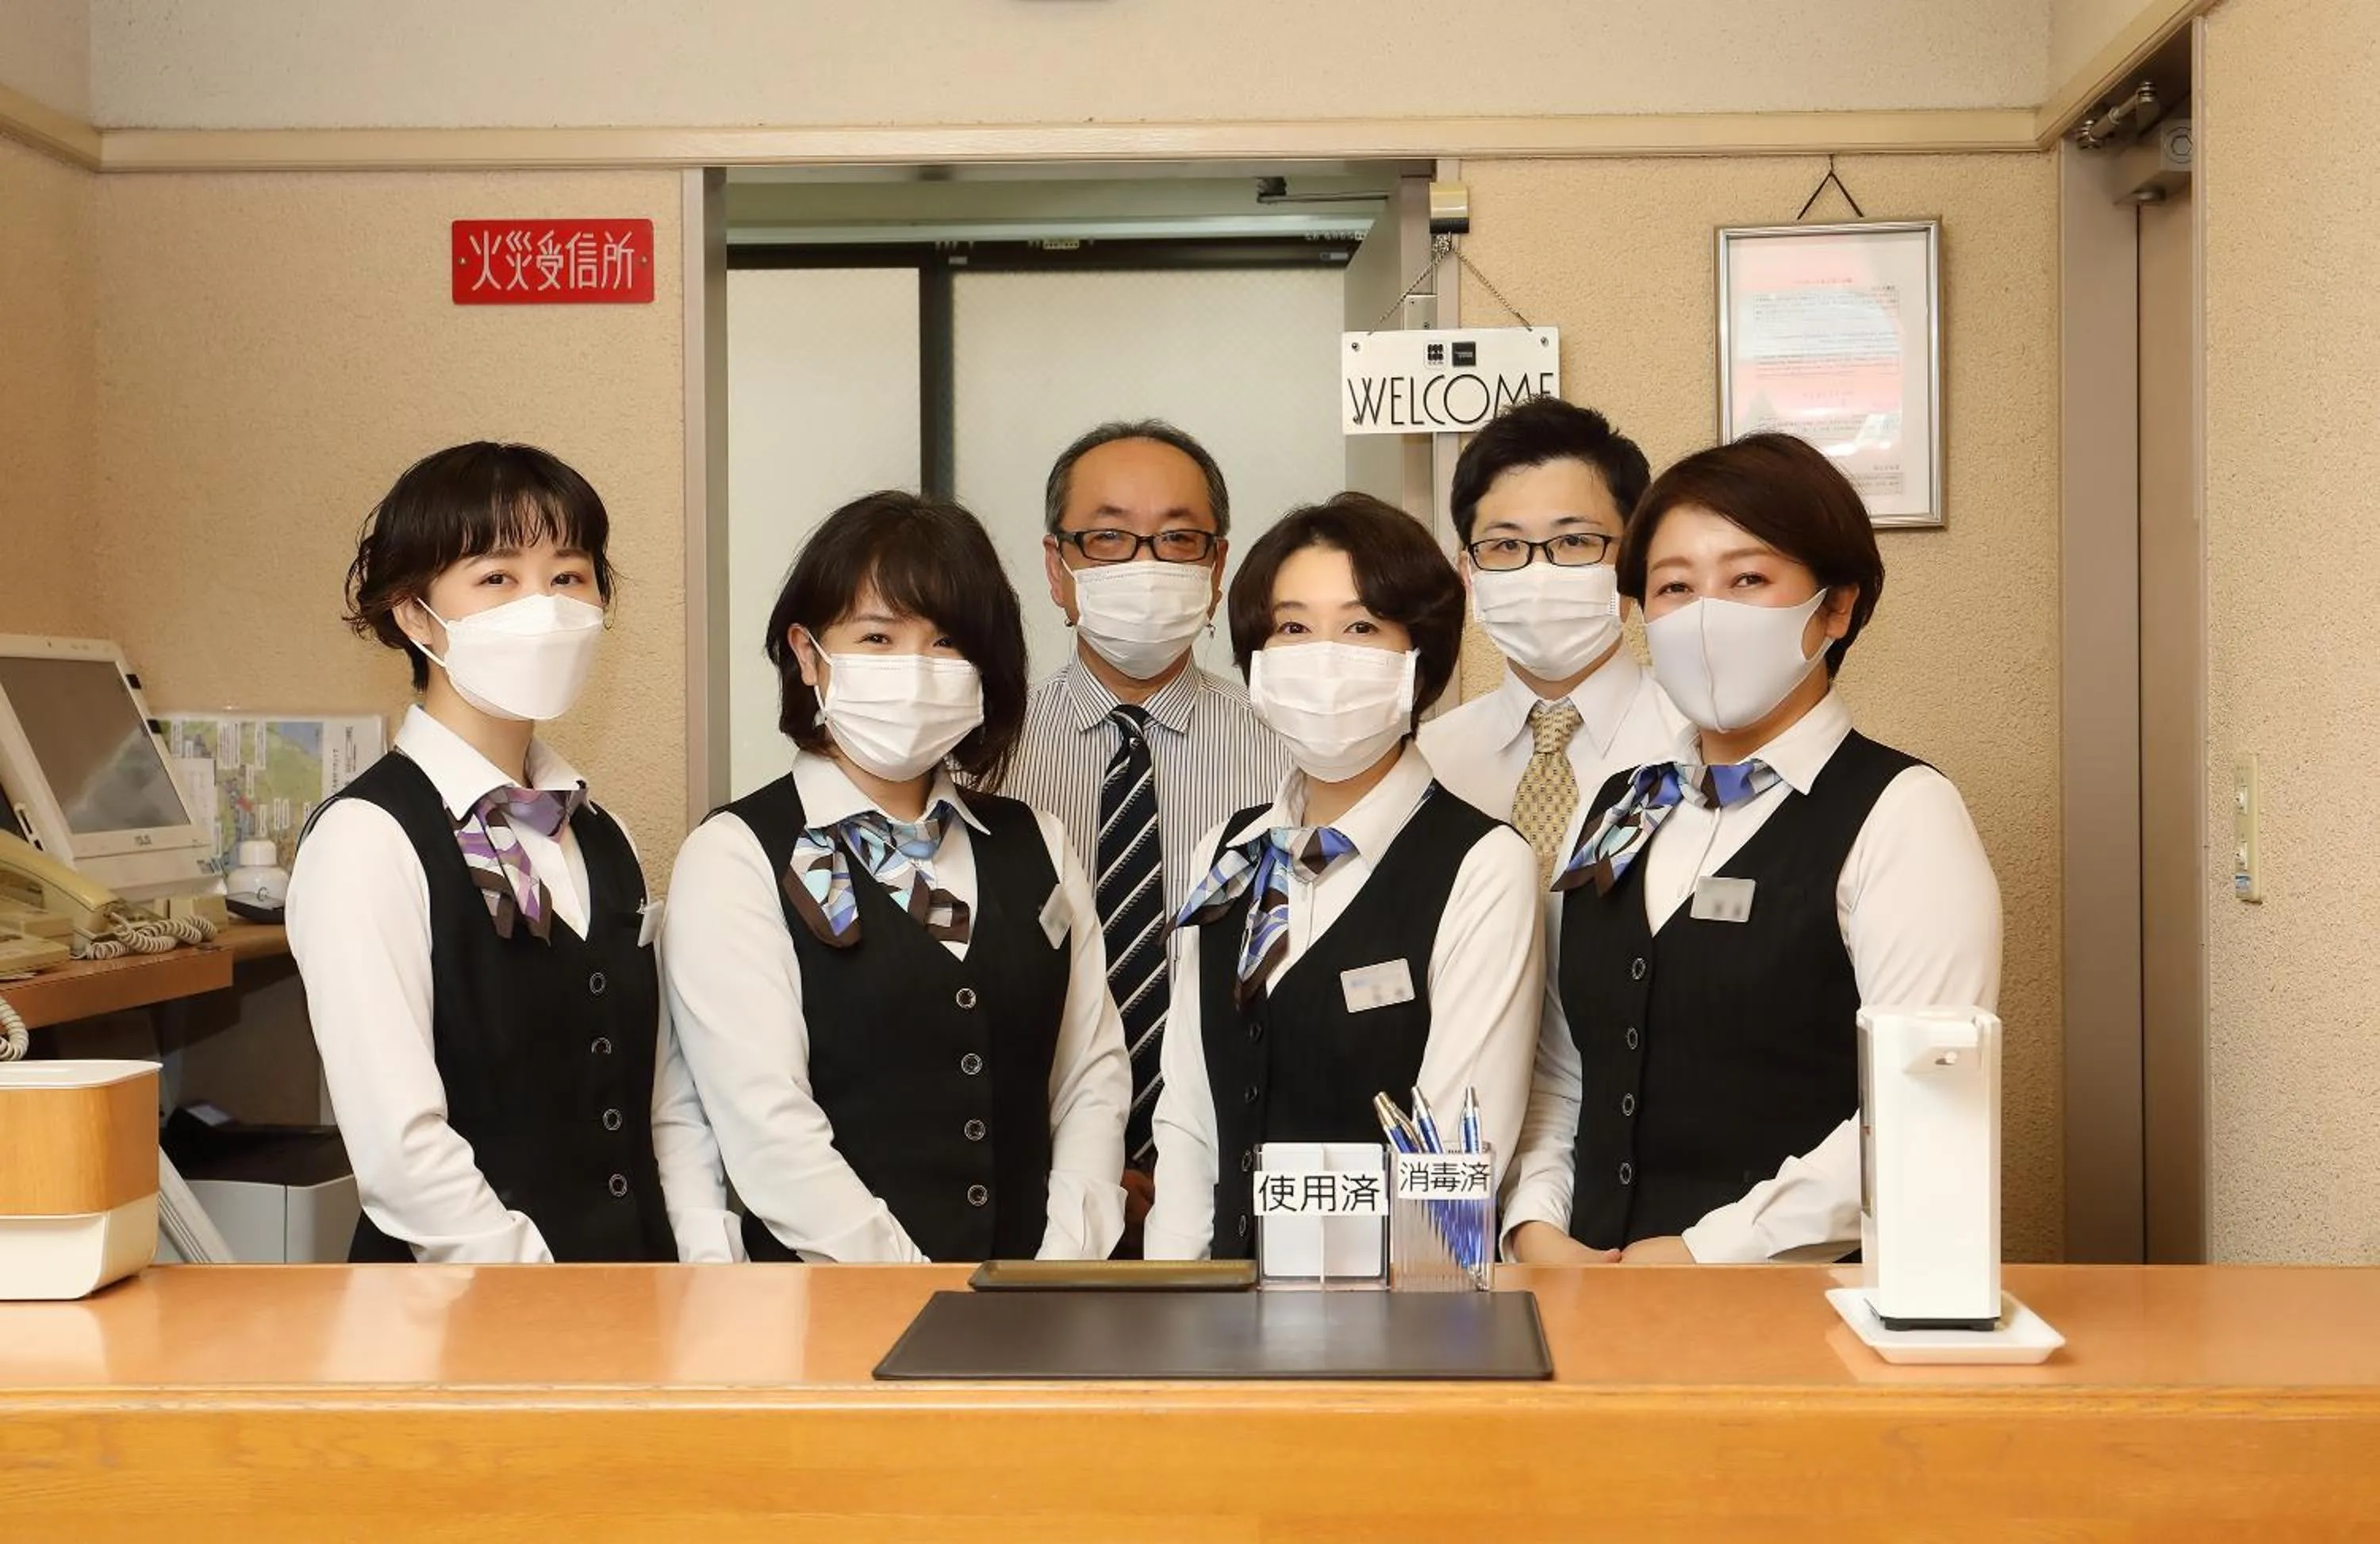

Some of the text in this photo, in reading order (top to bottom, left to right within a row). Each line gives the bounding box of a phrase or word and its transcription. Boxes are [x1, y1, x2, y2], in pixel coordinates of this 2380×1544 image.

[470, 230, 635, 290] 火災受信所
[1258, 1174, 1380, 1212] 使用済
[1400, 1162, 1490, 1192] 消毒済
